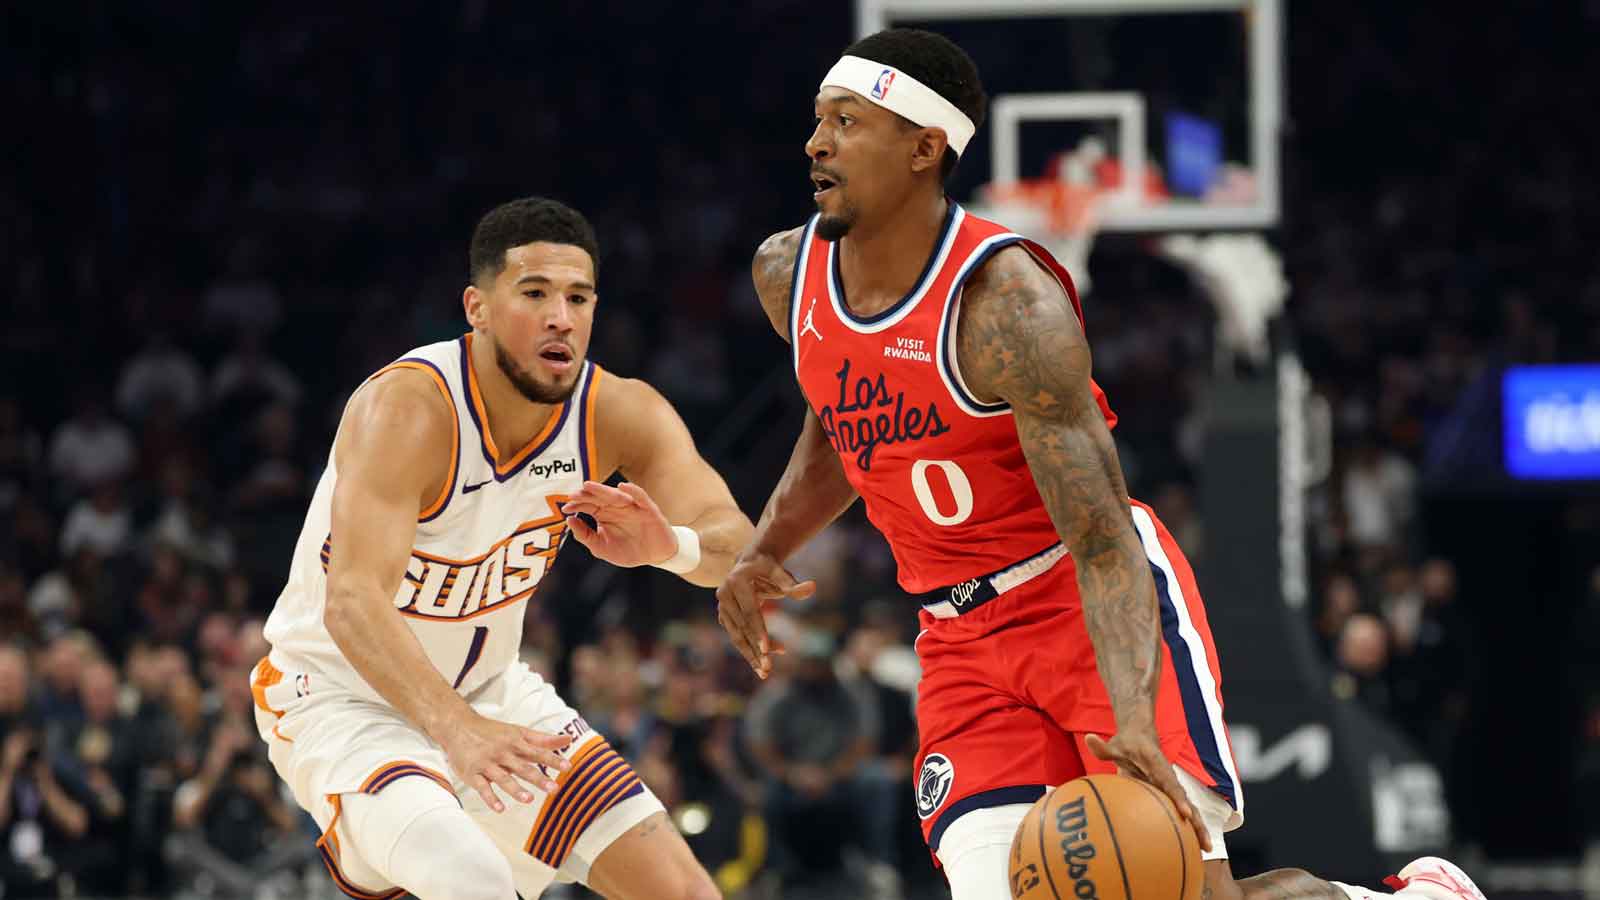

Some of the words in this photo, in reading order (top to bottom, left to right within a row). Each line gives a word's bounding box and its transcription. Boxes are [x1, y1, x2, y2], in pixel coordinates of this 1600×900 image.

[883, 346, 932, 363] RWANDA
[896, 336, 925, 350] VISIT
[836, 358, 893, 413] Los
[820, 392, 950, 472] Angeles
[911, 459, 973, 526] 0
[951, 577, 981, 606] Clips
[453, 626, 489, 690] 1
[1055, 795, 1097, 900] Wilso
